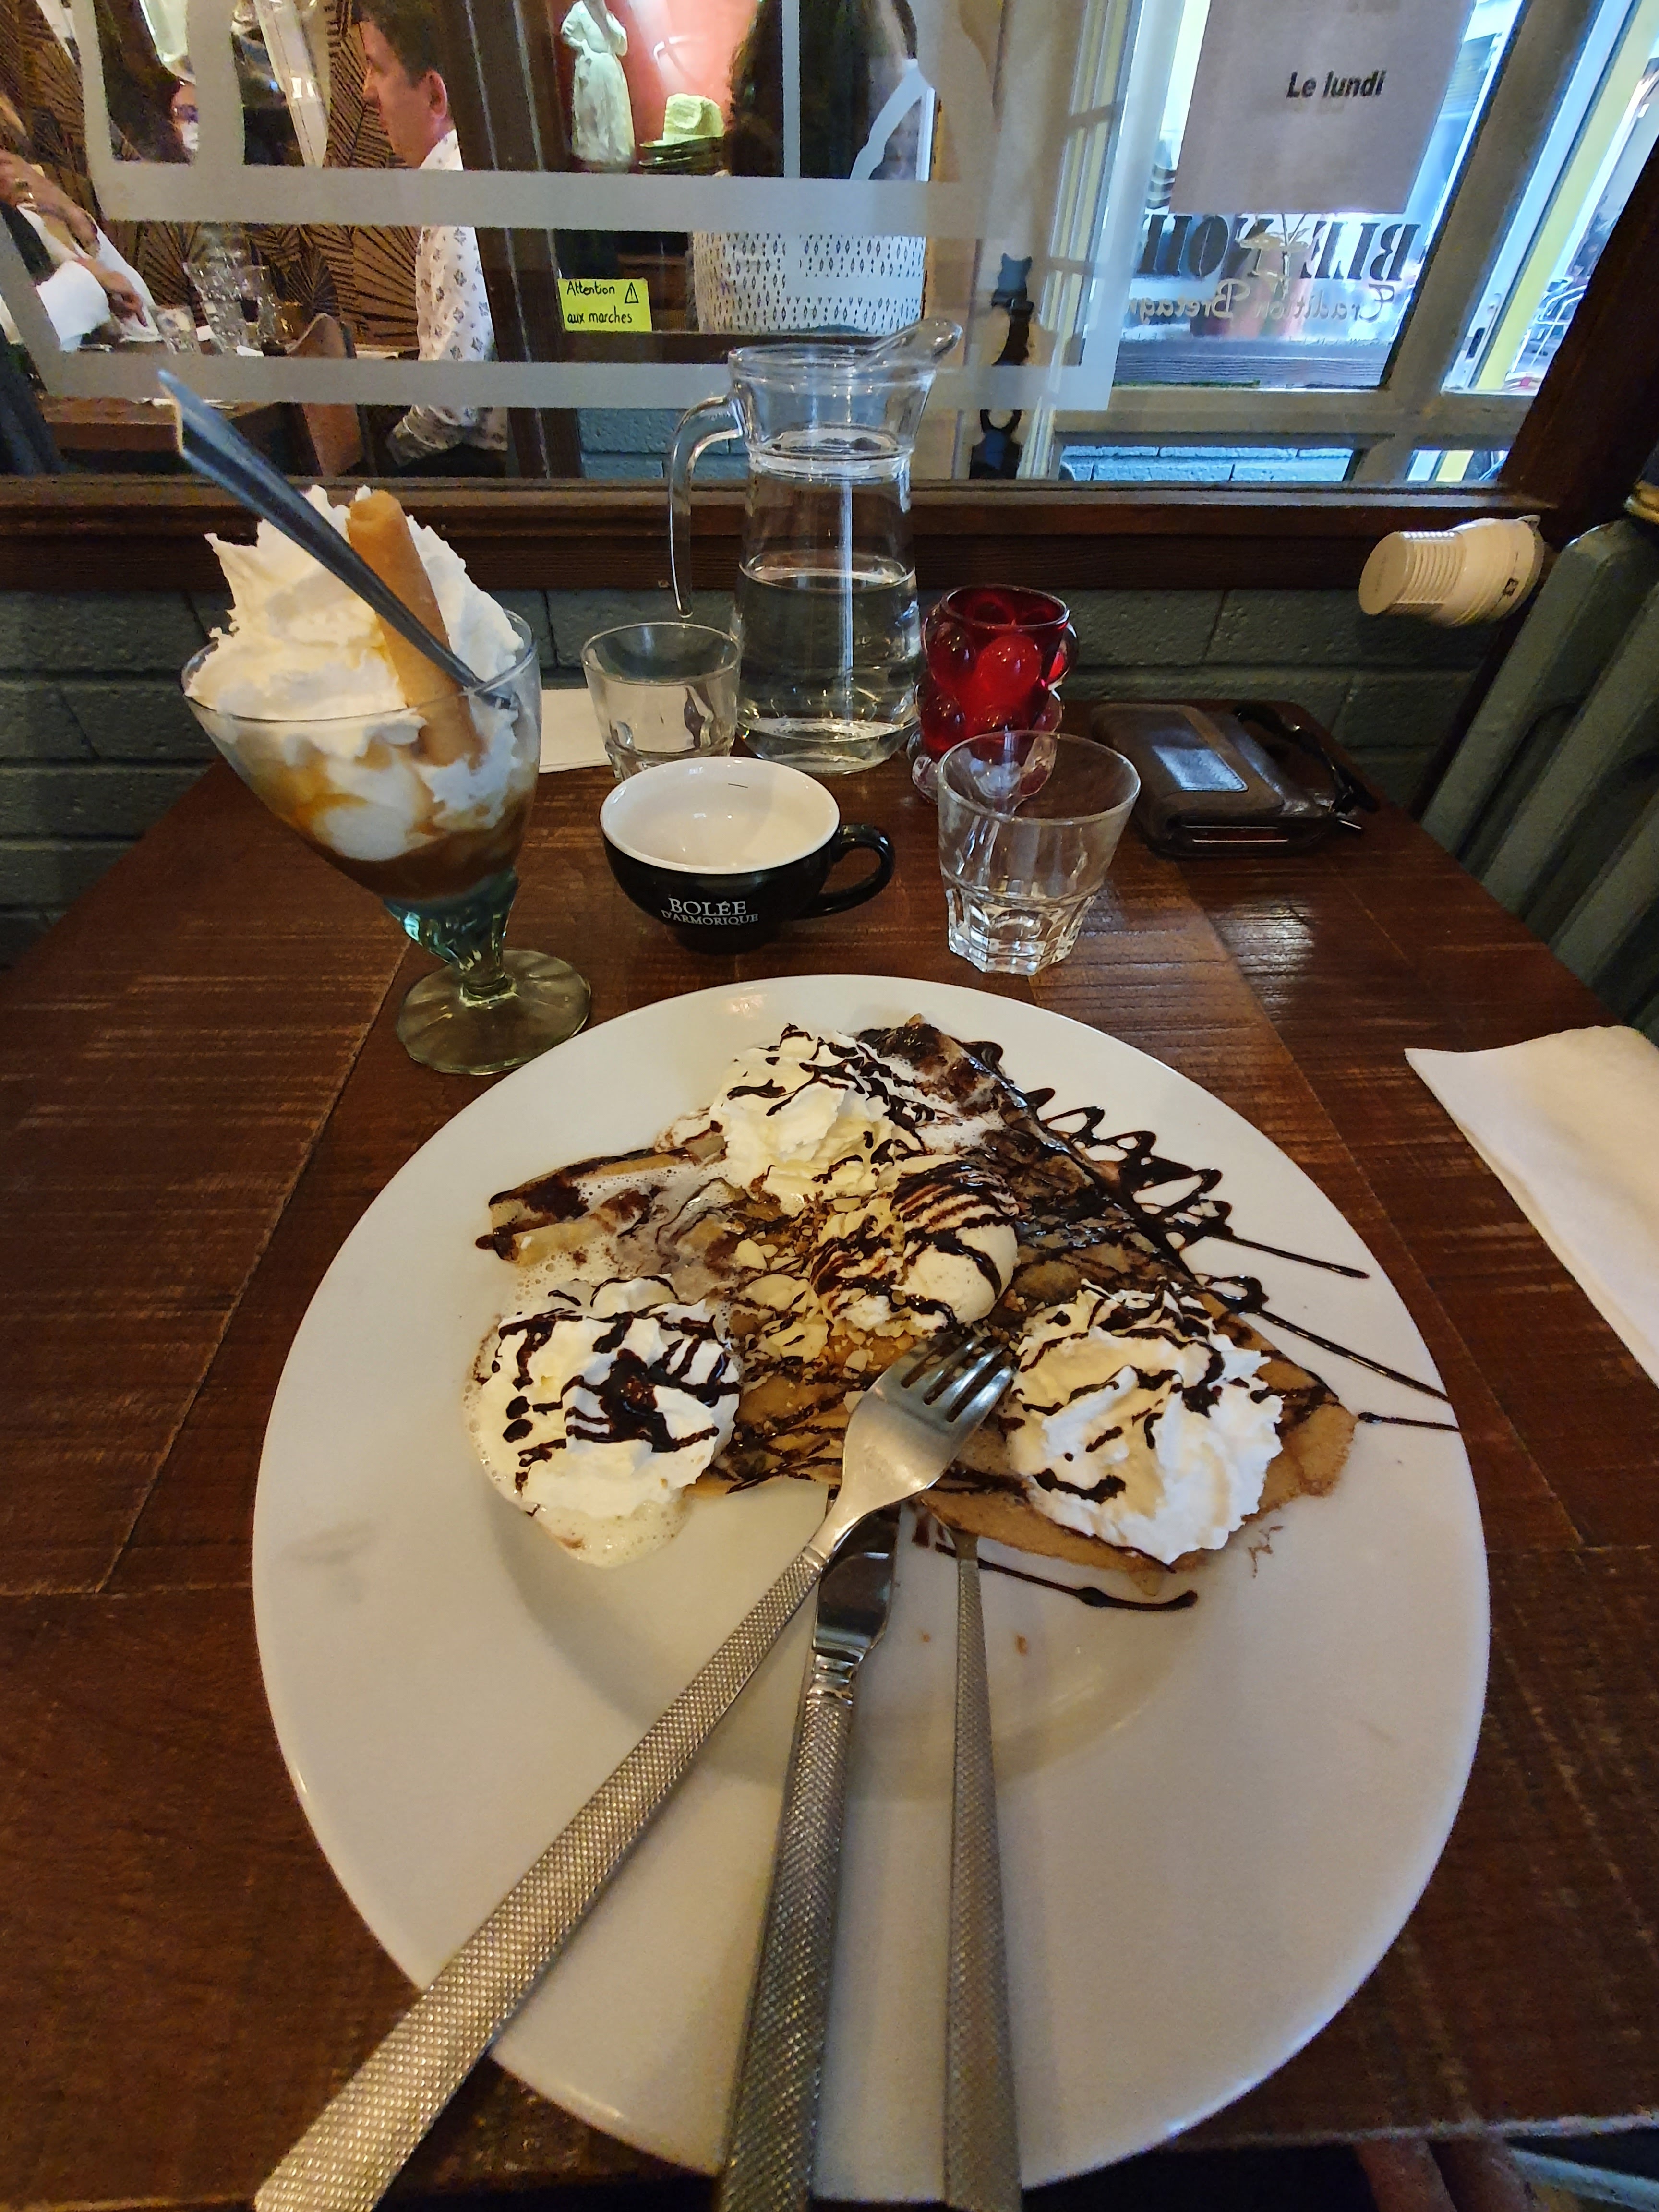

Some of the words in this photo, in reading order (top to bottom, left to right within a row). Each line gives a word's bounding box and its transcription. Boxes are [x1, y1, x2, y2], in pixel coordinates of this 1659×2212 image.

[1286, 71, 1316, 98] Le
[1322, 70, 1387, 98] lundi
[567, 281, 615, 296] Attention
[567, 313, 585, 324] aux
[589, 305, 632, 323] marches
[668, 897, 746, 916] BOLÉE
[661, 909, 758, 926] D'ARMORIQUE
